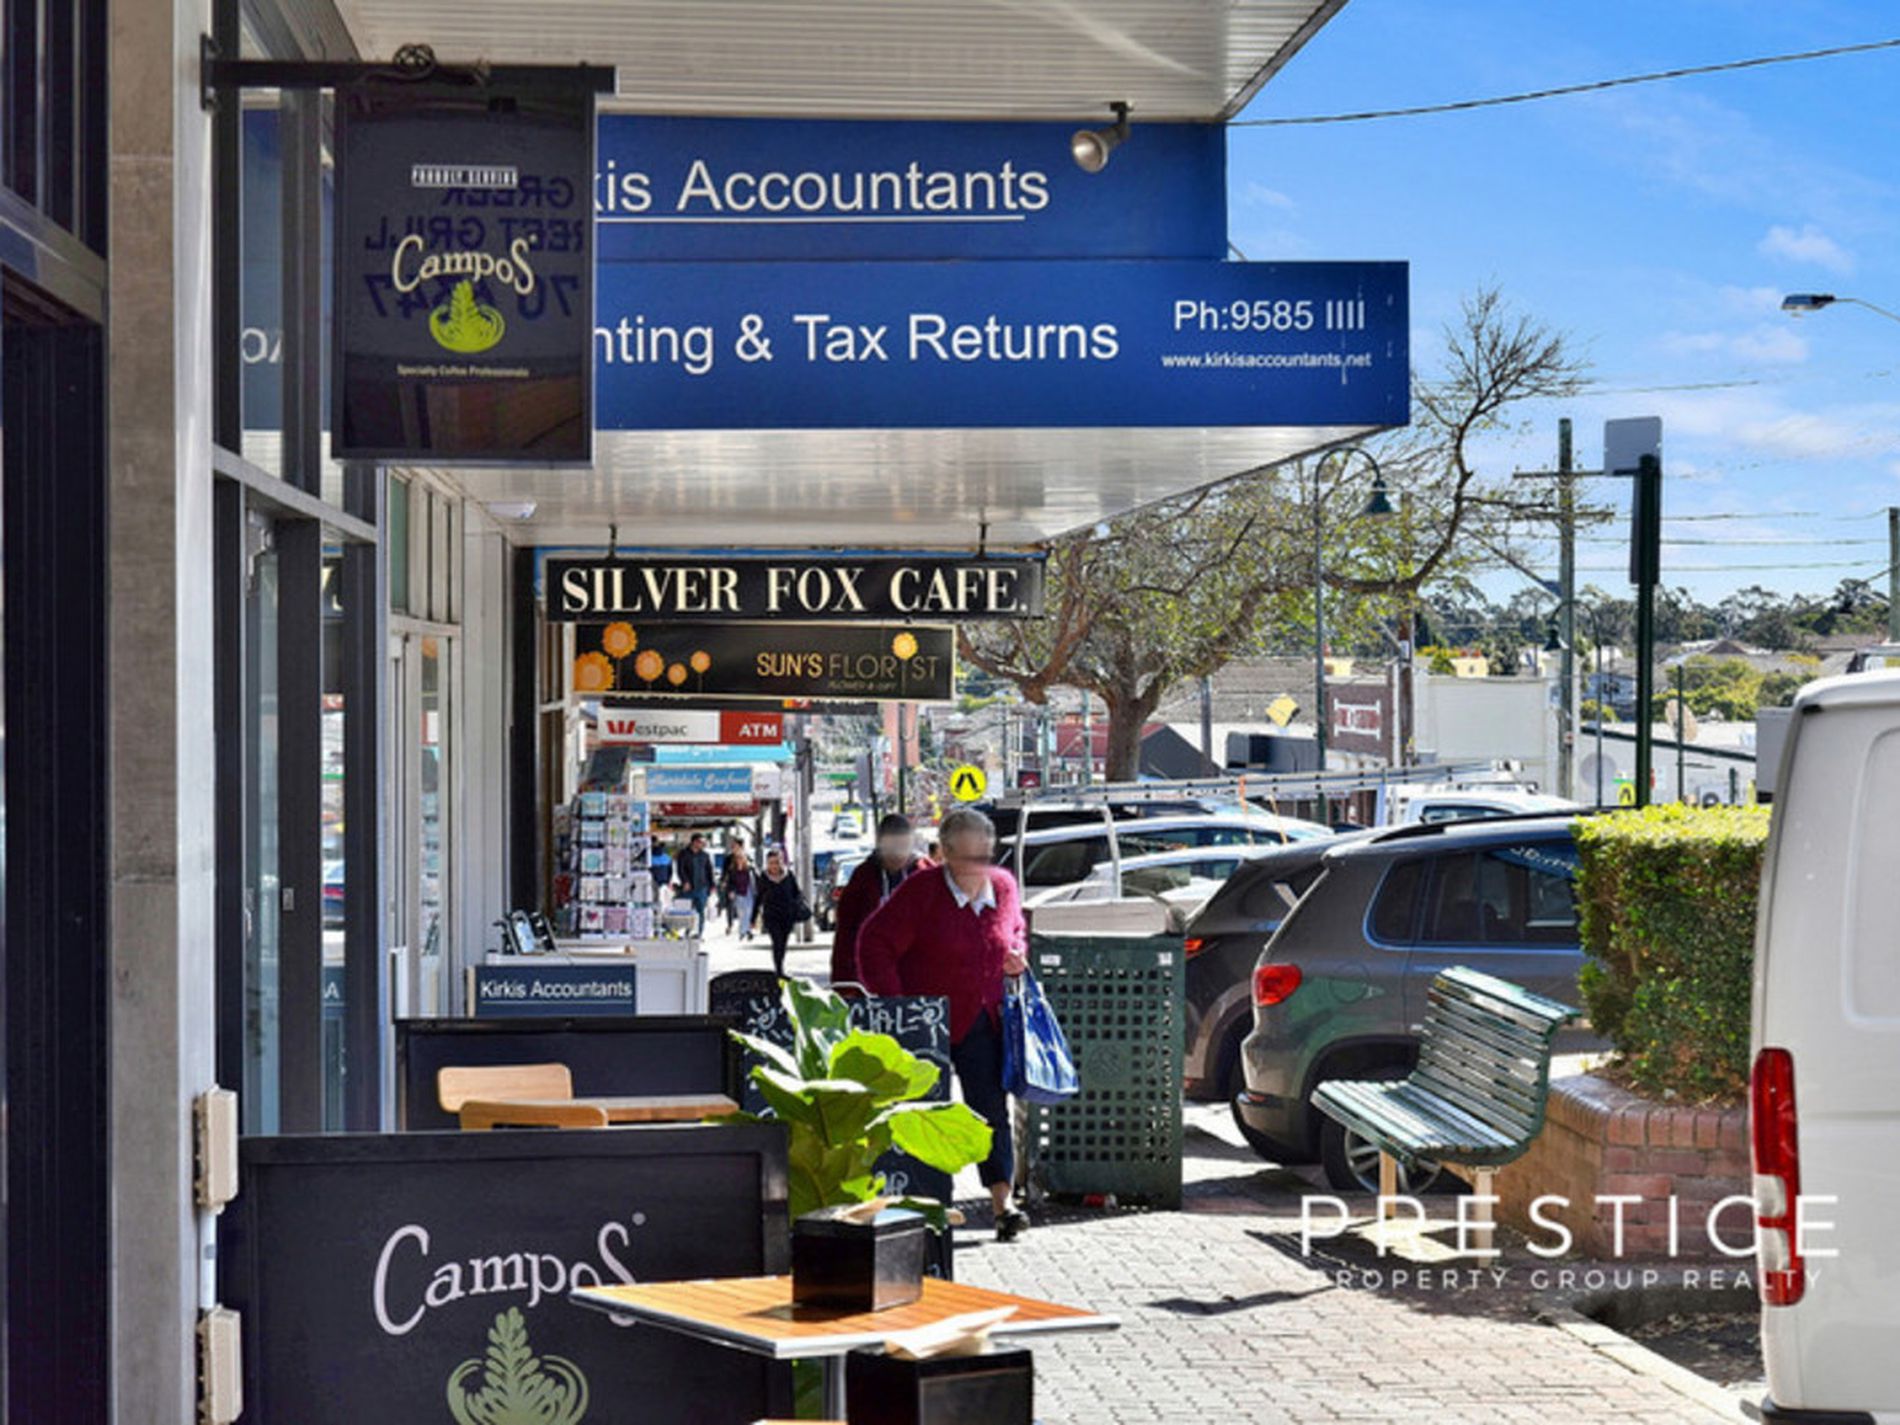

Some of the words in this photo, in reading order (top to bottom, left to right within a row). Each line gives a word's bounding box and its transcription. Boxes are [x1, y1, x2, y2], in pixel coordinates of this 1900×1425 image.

[677, 159, 1049, 211] Accountants
[1174, 300, 1314, 331] Ph:9585
[734, 313, 774, 362] &
[793, 314, 889, 362] Tax
[908, 313, 1120, 362] Returns
[561, 566, 742, 613] SILVER
[766, 566, 869, 613] FOX
[757, 652, 823, 679] SUN'S
[606, 719, 688, 738] Westpac
[738, 723, 779, 738] ATM
[479, 980, 526, 998] Kirkis
[530, 979, 633, 998] Accountants
